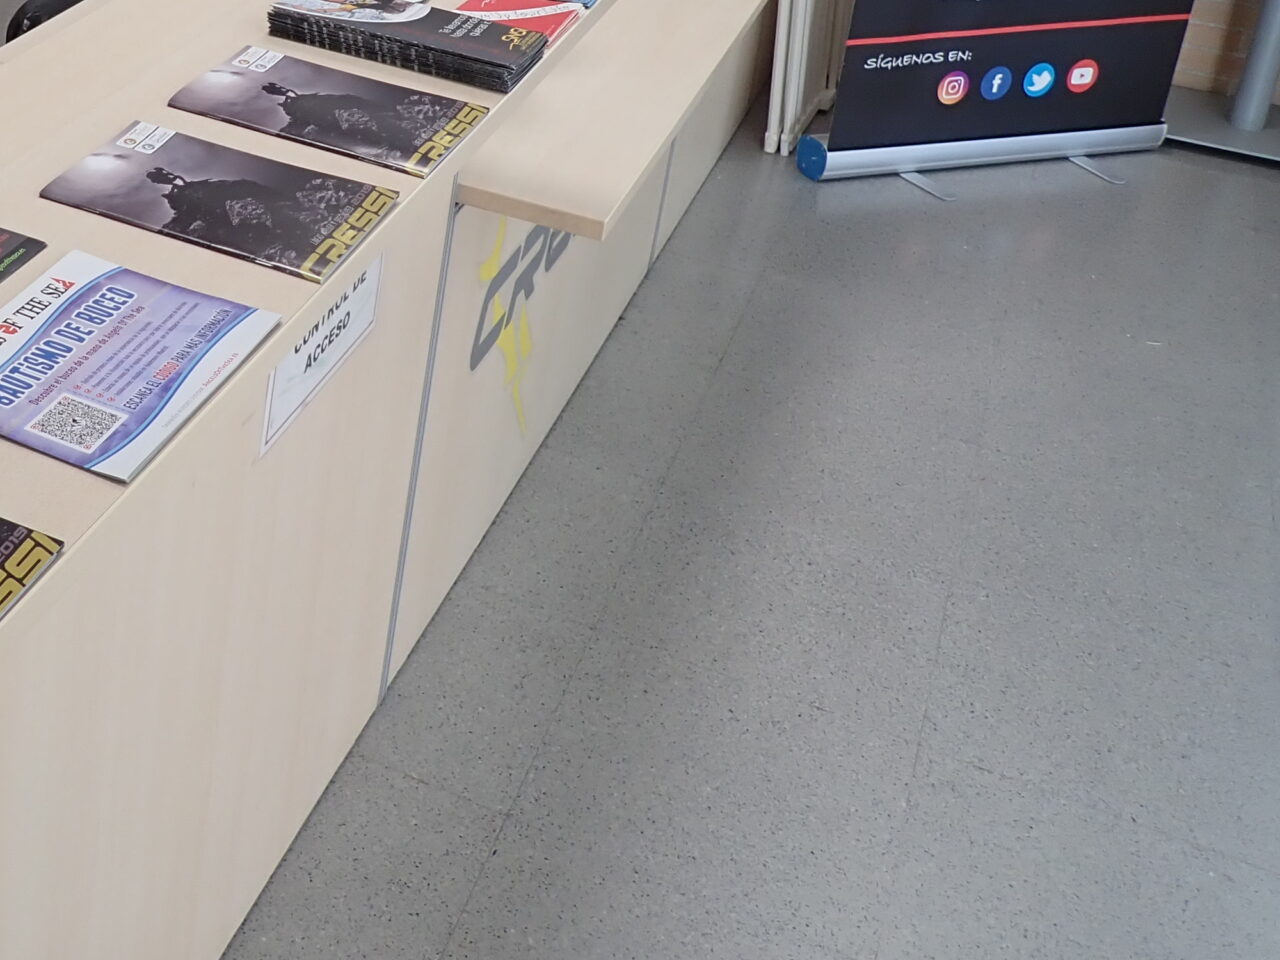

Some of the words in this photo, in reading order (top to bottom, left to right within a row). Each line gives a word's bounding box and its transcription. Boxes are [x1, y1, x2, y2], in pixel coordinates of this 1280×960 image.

[407, 103, 489, 176] CRESSI
[300, 186, 399, 281] CRESSI
[10, 295, 53, 321] THE
[37, 276, 76, 299] SEA
[71, 284, 137, 326] BUCEO
[52, 320, 96, 343] DE
[304, 310, 351, 374] ACCESO
[56, 364, 79, 380] buceo
[122, 384, 155, 410] ESCANEA
[144, 377, 163, 388] EL
[169, 348, 192, 363] PARA
